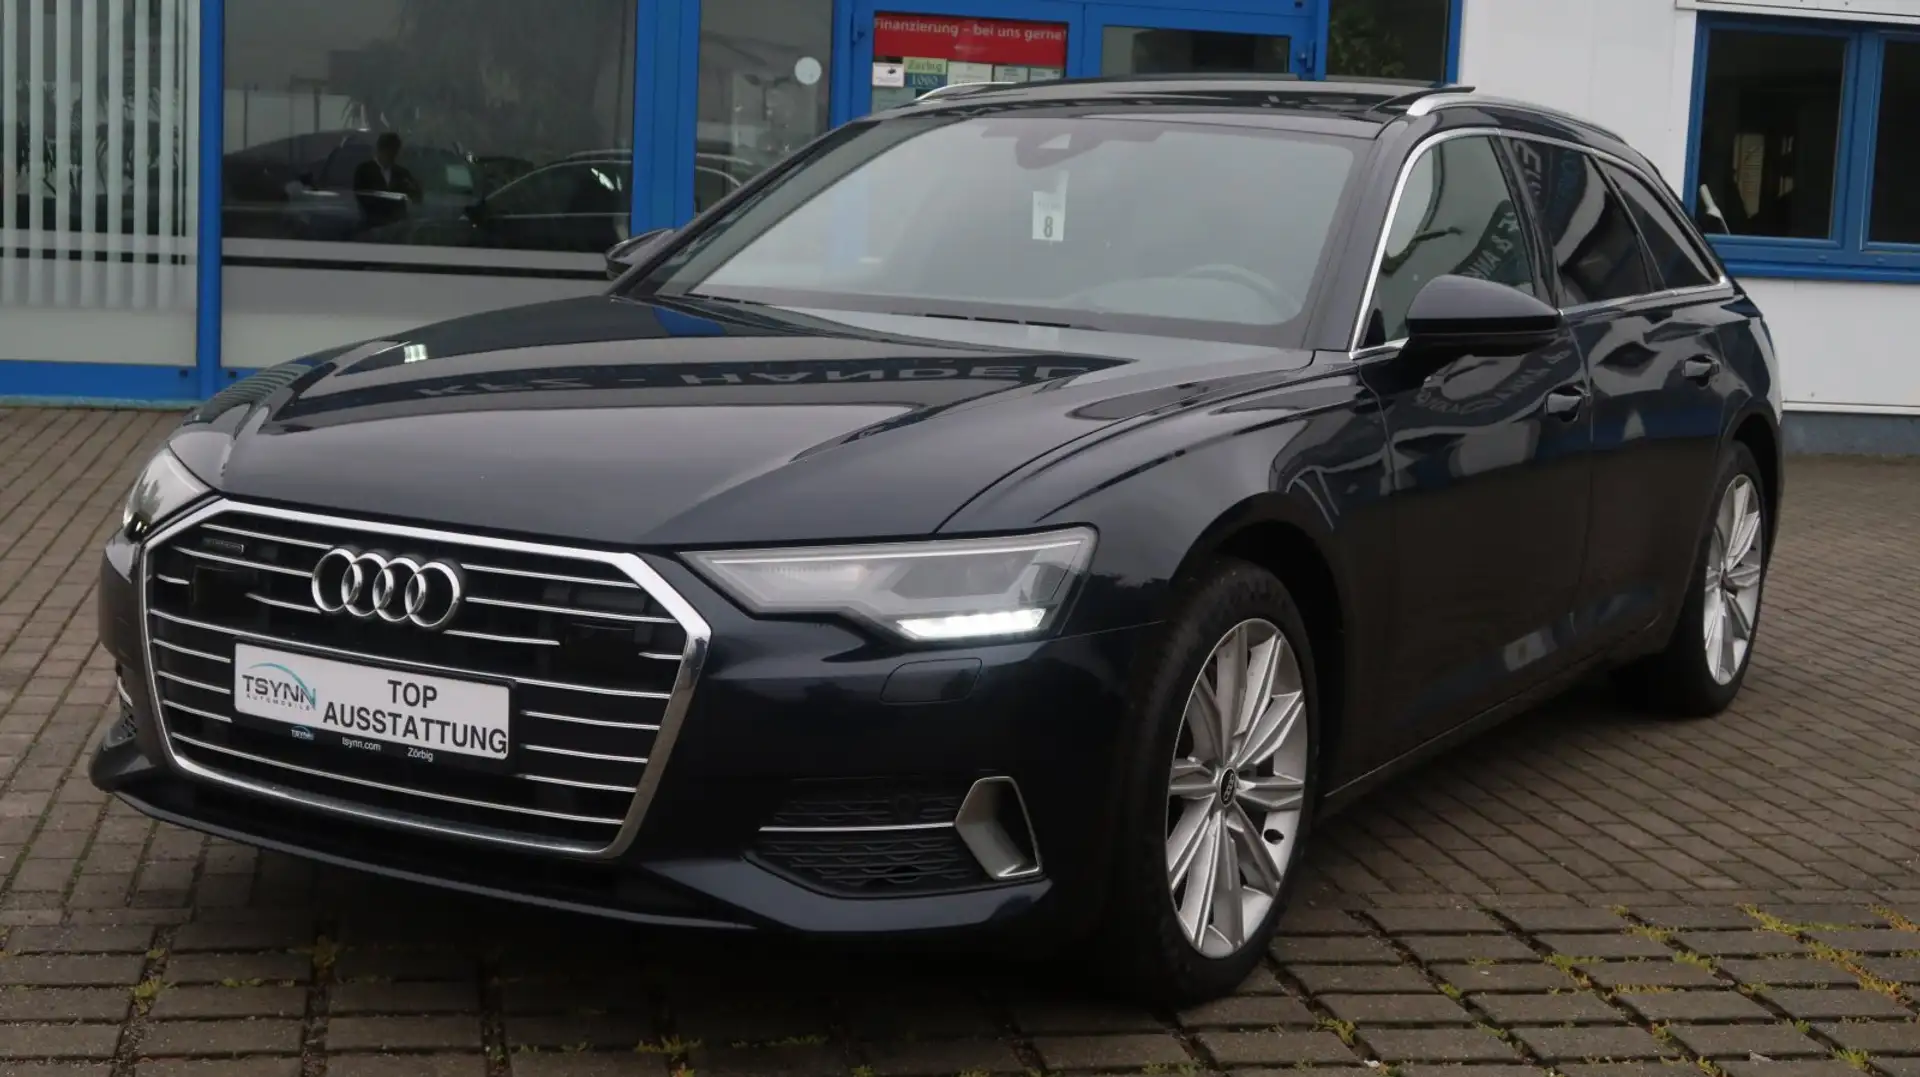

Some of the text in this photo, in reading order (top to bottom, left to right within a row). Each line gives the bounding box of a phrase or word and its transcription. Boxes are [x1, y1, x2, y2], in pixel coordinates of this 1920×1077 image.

[973, 22, 994, 37] bei
[997, 28, 1021, 39] uns
[1043, 215, 1054, 239] 8
[242, 674, 317, 710] TSYNN
[387, 679, 438, 708] TOP
[323, 701, 507, 754] AUSSTATTUNG
[341, 736, 382, 751] tsynn.com
